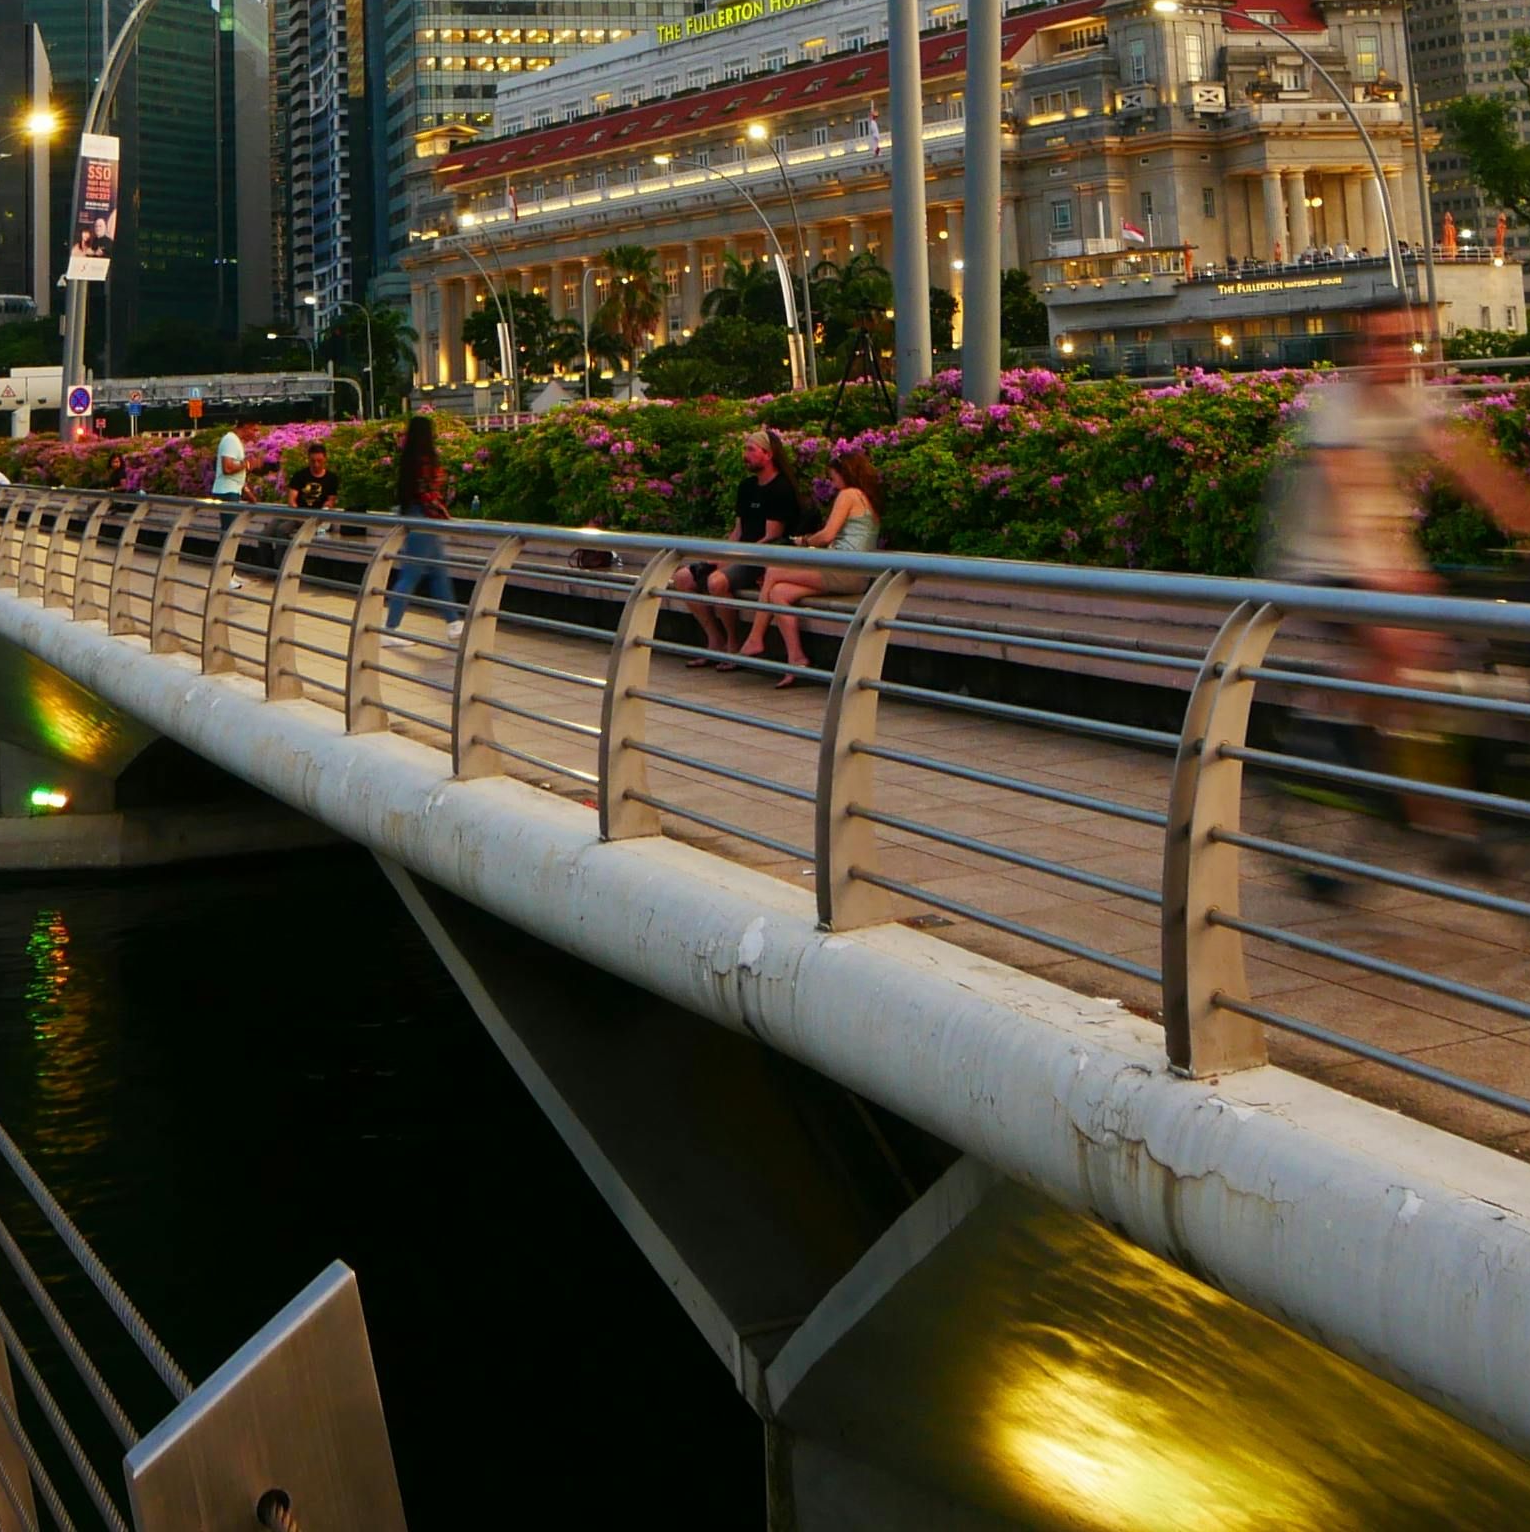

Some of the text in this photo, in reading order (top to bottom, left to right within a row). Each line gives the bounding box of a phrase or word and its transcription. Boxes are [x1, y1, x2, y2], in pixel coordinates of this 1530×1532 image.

[657, 23, 682, 45] THE
[685, 0, 765, 36] FULLERTON
[87, 165, 111, 181] SSO
[1217, 284, 1235, 295] THE
[1236, 280, 1283, 294] FULLERTON
